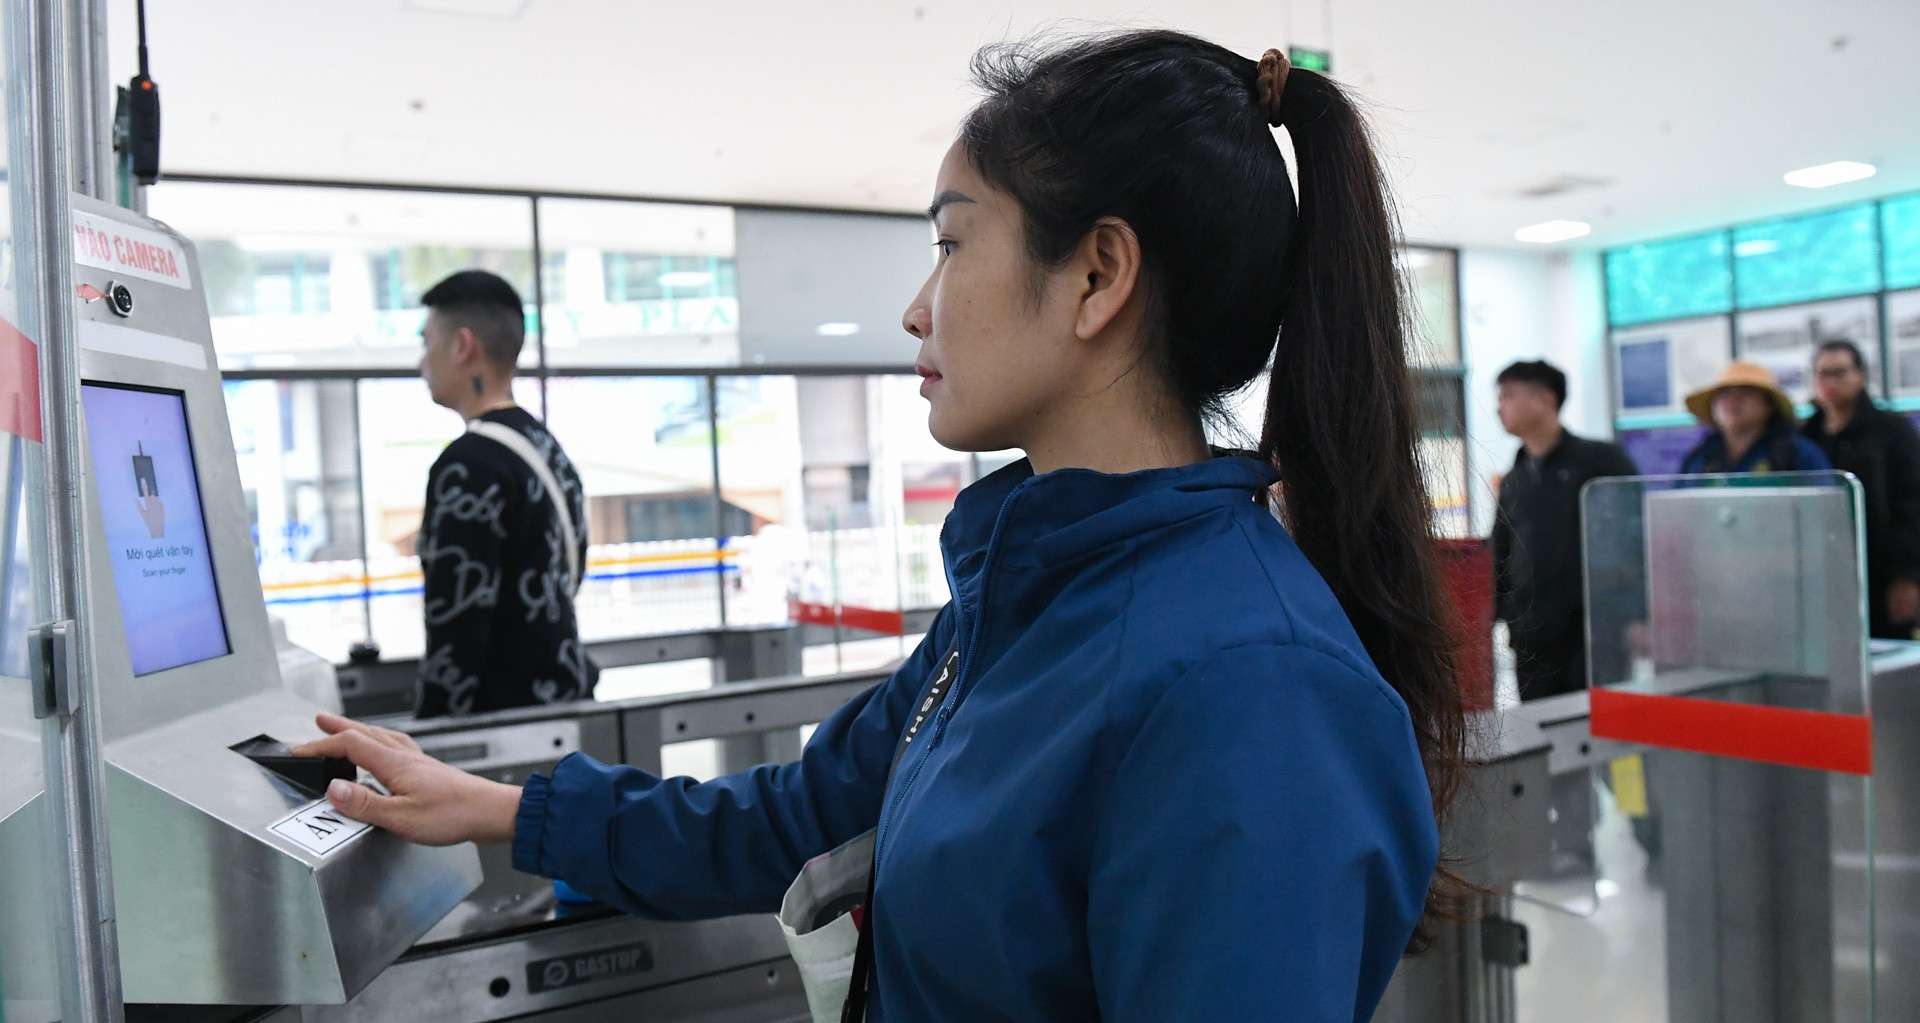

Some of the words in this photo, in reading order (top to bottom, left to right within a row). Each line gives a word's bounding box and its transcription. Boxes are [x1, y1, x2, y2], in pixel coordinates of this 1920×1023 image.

[113, 234, 180, 279] CAMERA
[181, 545, 194, 558] tay
[142, 568, 158, 578] Scan
[159, 567, 171, 578] your
[170, 566, 187, 576] finger
[574, 948, 642, 979] GASTOP
